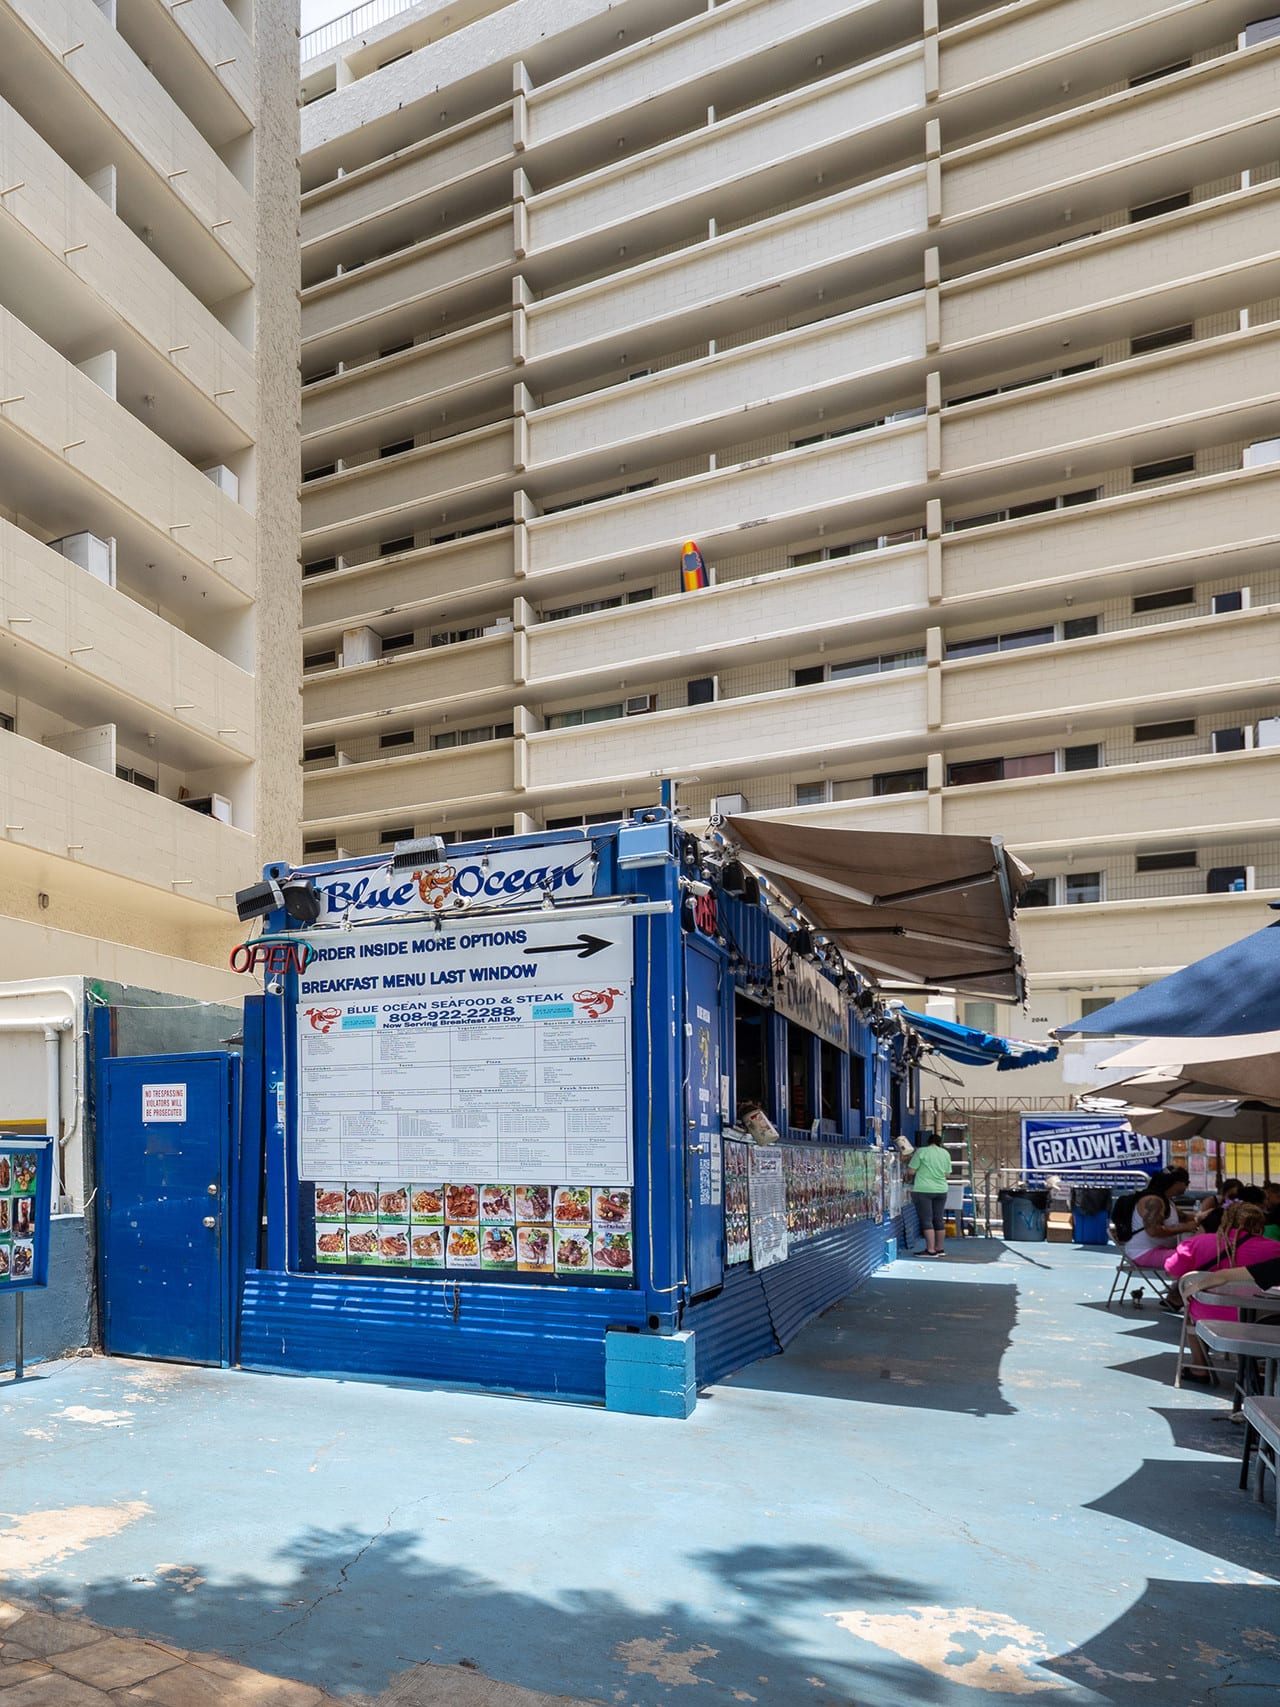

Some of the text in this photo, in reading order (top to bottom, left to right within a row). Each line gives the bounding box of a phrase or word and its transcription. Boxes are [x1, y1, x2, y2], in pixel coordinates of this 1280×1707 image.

[322, 863, 584, 913] Blue Ocean
[360, 941, 408, 957] INSIDE
[413, 937, 456, 954] MORE
[460, 930, 527, 948] OPTIONS
[229, 944, 308, 975] OPEN
[302, 964, 537, 994] BREAKFAST MENU LAST WINDOW
[347, 993, 564, 1014] BLUE OCEAN SEAFOOD & STEAK
[389, 1006, 515, 1023] 808-922-2288
[404, 1021, 438, 1029] Serving
[441, 1018, 485, 1026] Breakfast
[504, 1015, 522, 1023] Day
[153, 1089, 183, 1097] TRESPASSING
[146, 1099, 169, 1107] VIOLATORS
[146, 1108, 182, 1117] BE PROSECUTED
